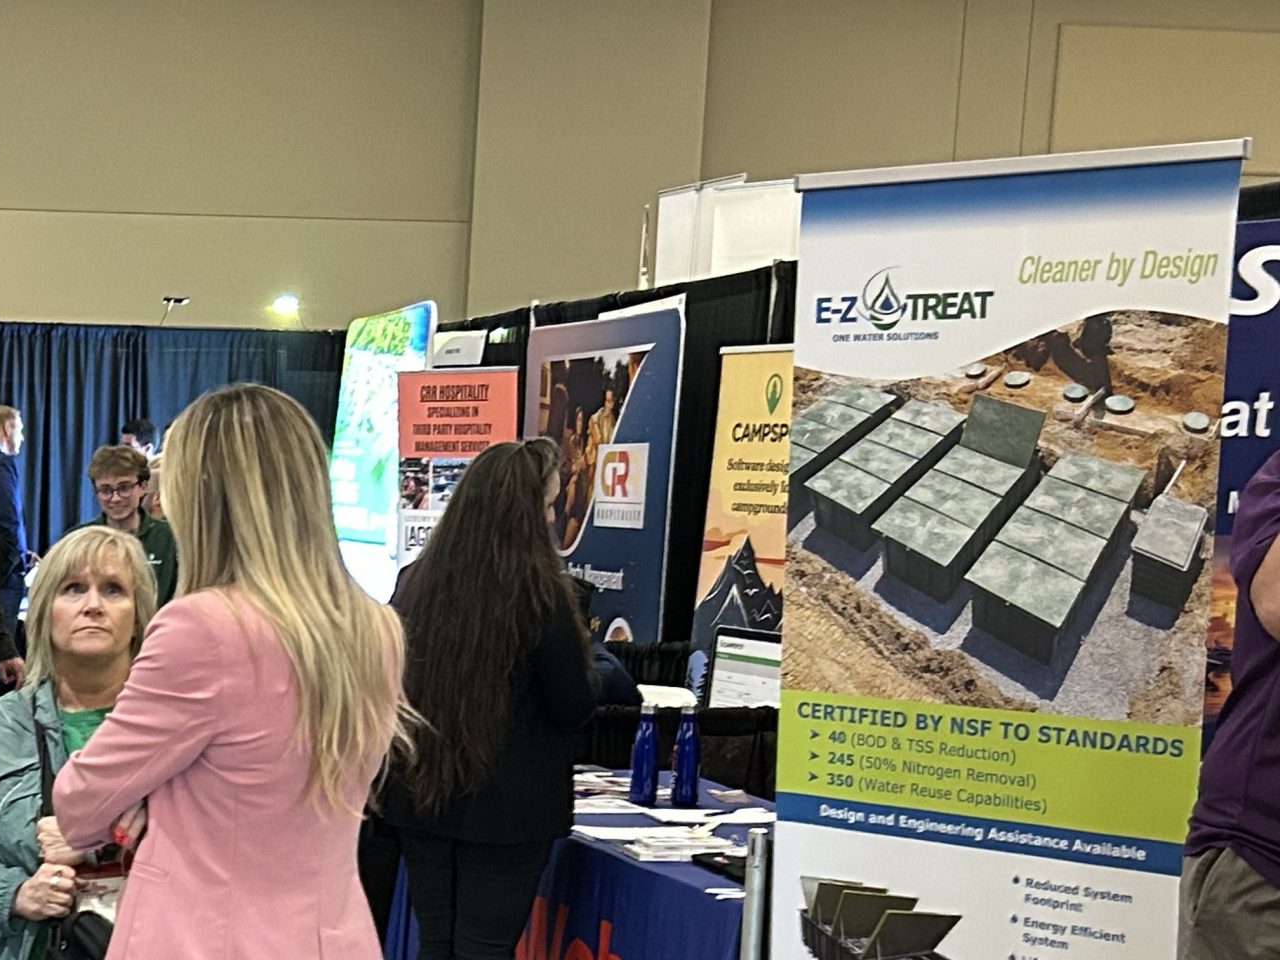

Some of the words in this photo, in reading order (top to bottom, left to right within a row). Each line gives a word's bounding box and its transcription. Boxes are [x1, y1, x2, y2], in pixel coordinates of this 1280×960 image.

[1019, 255, 1102, 285] Cleaner
[1108, 251, 1136, 286] by
[1140, 248, 1218, 284] Design
[816, 296, 857, 324] E-Z
[906, 290, 995, 321] TREAT
[832, 333, 851, 343] ONE
[853, 332, 884, 343] WATER
[886, 331, 940, 341] SOLUTIONS
[439, 384, 490, 401] HOSPITALITY
[732, 422, 789, 443] CAMPSP
[727, 458, 765, 472] Software
[766, 458, 789, 474] desig
[733, 478, 779, 495] exclusively
[797, 701, 908, 729] CERTIFIED
[915, 712, 942, 732] BY
[950, 718, 992, 738] NSF
[1000, 723, 1030, 742] TO
[1038, 726, 1185, 759] STANDARDS
[828, 730, 847, 745] 40
[850, 731, 888, 749] (BOD
[892, 735, 901, 750] &
[906, 738, 935, 754] TSS
[939, 742, 1017, 766] Reduction)
[827, 751, 855, 767] 245
[858, 753, 896, 773] (50%
[902, 759, 961, 782] Nitrogen
[966, 767, 1037, 791] Removal)
[826, 772, 854, 788] 350
[858, 775, 906, 797] (Water
[910, 782, 953, 801] Reuse
[957, 787, 1048, 815] Capabilities)
[819, 804, 865, 824] Design
[868, 811, 895, 827] and
[899, 814, 984, 841] Engineering
[988, 826, 1069, 850] Assistance
[1072, 838, 1147, 862] Available
[1024, 893, 1083, 913] Footprint
[1025, 877, 1081, 896] Reduced
[1082, 886, 1134, 904] System
[1022, 932, 1069, 950] System
[1023, 916, 1068, 936] Energy
[1071, 925, 1127, 944] Efficient
